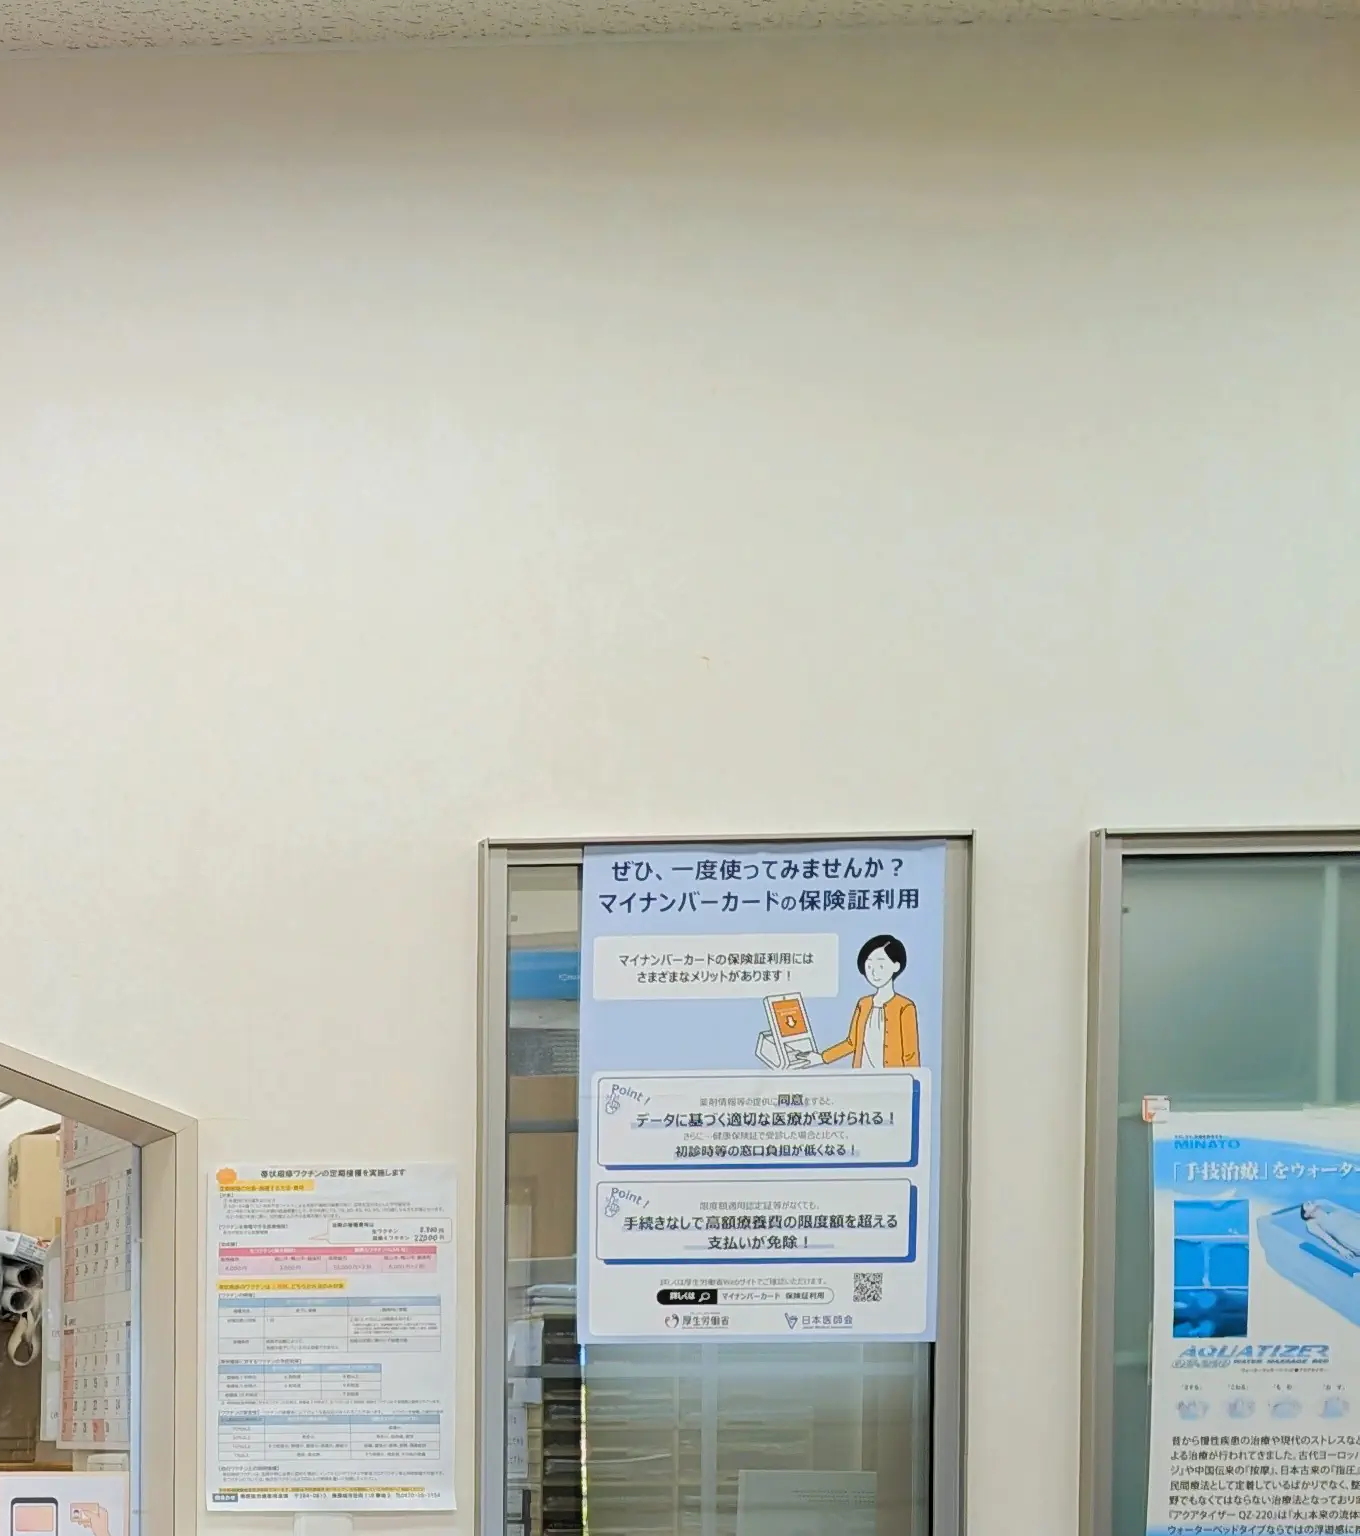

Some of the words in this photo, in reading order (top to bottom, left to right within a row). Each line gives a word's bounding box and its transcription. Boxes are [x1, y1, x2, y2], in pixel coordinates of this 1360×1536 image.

[611, 858, 905, 882] ぜひ、一度使ってみませんか？
[598, 888, 919, 914] マイナンバーカードの保険証利用
[618, 952, 814, 966] マイナンバーカードの保険証利用には
[1174, 1140, 1240, 1150] MINATO
